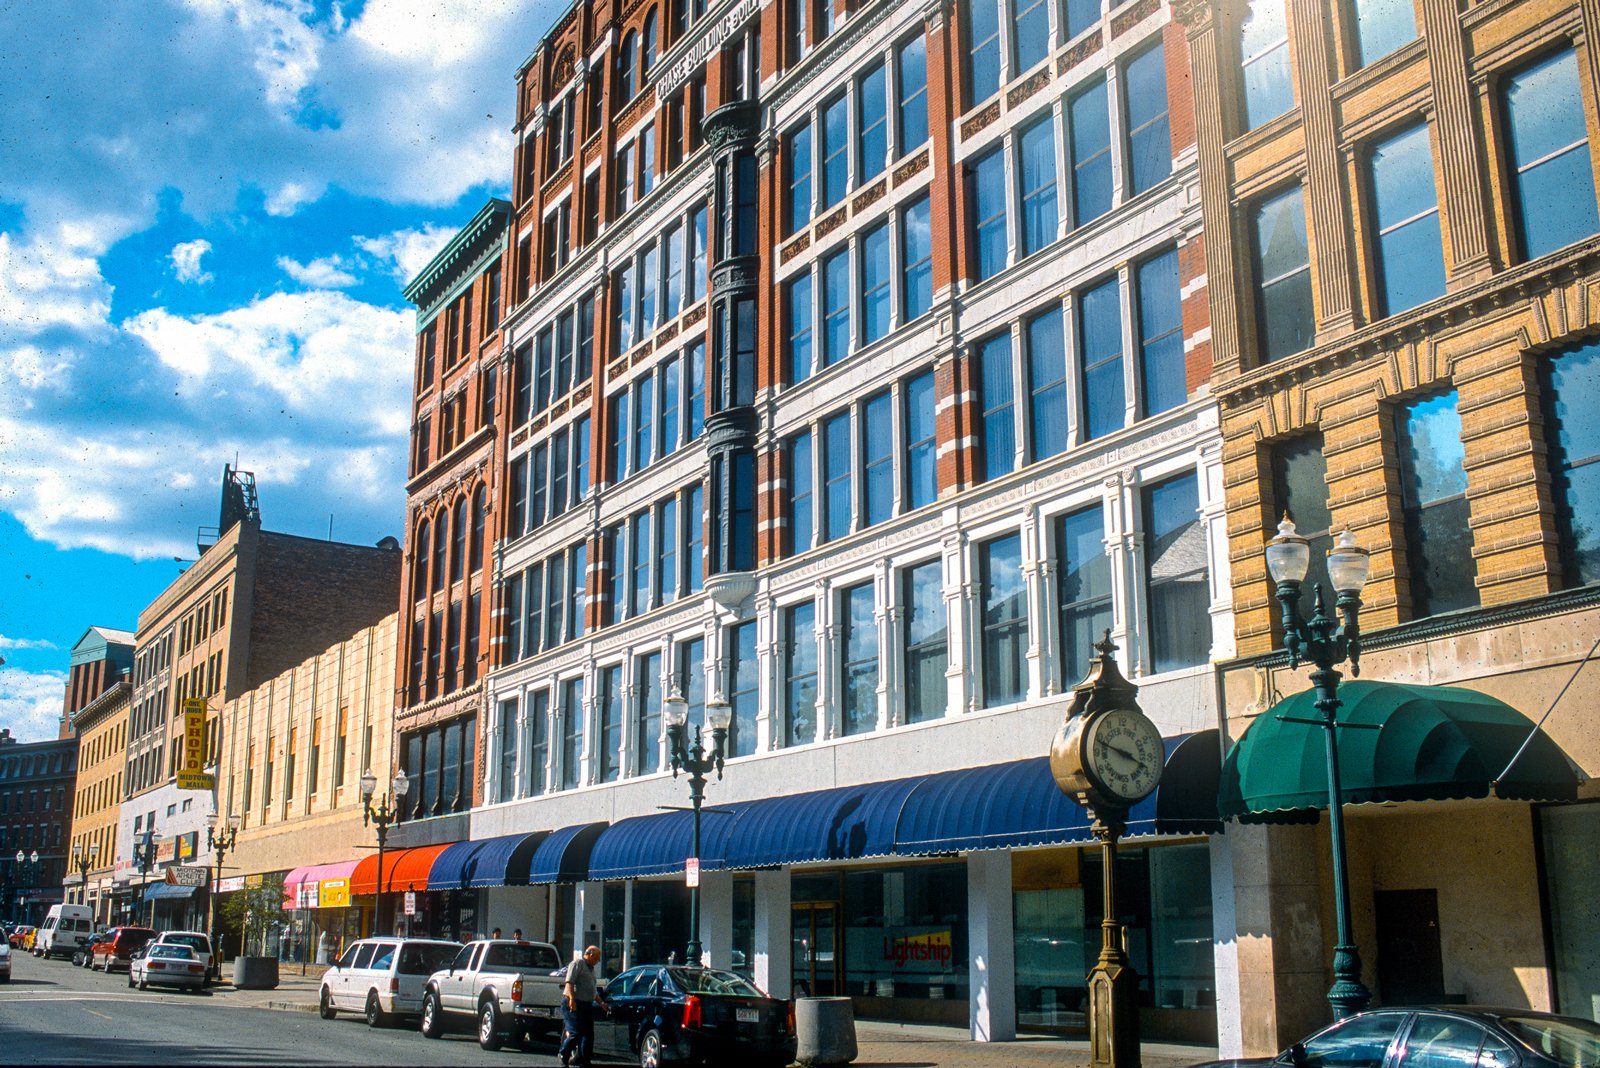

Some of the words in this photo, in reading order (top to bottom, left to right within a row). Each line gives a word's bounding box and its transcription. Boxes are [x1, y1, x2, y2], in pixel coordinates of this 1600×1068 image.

[657, 57, 686, 99] CHASE
[688, 16, 731, 71] BUILDING
[1118, 717, 1127, 727] 12
[187, 718, 201, 769] PHOTO
[1142, 735, 1149, 745] 2
[1135, 740, 1147, 762] CENTS
[1146, 752, 1153, 762] 3
[1104, 760, 1129, 783] SAVINGS
[1121, 783, 1128, 793] 6
[1135, 780, 1142, 790] 5
[883, 936, 951, 968] Lightship
